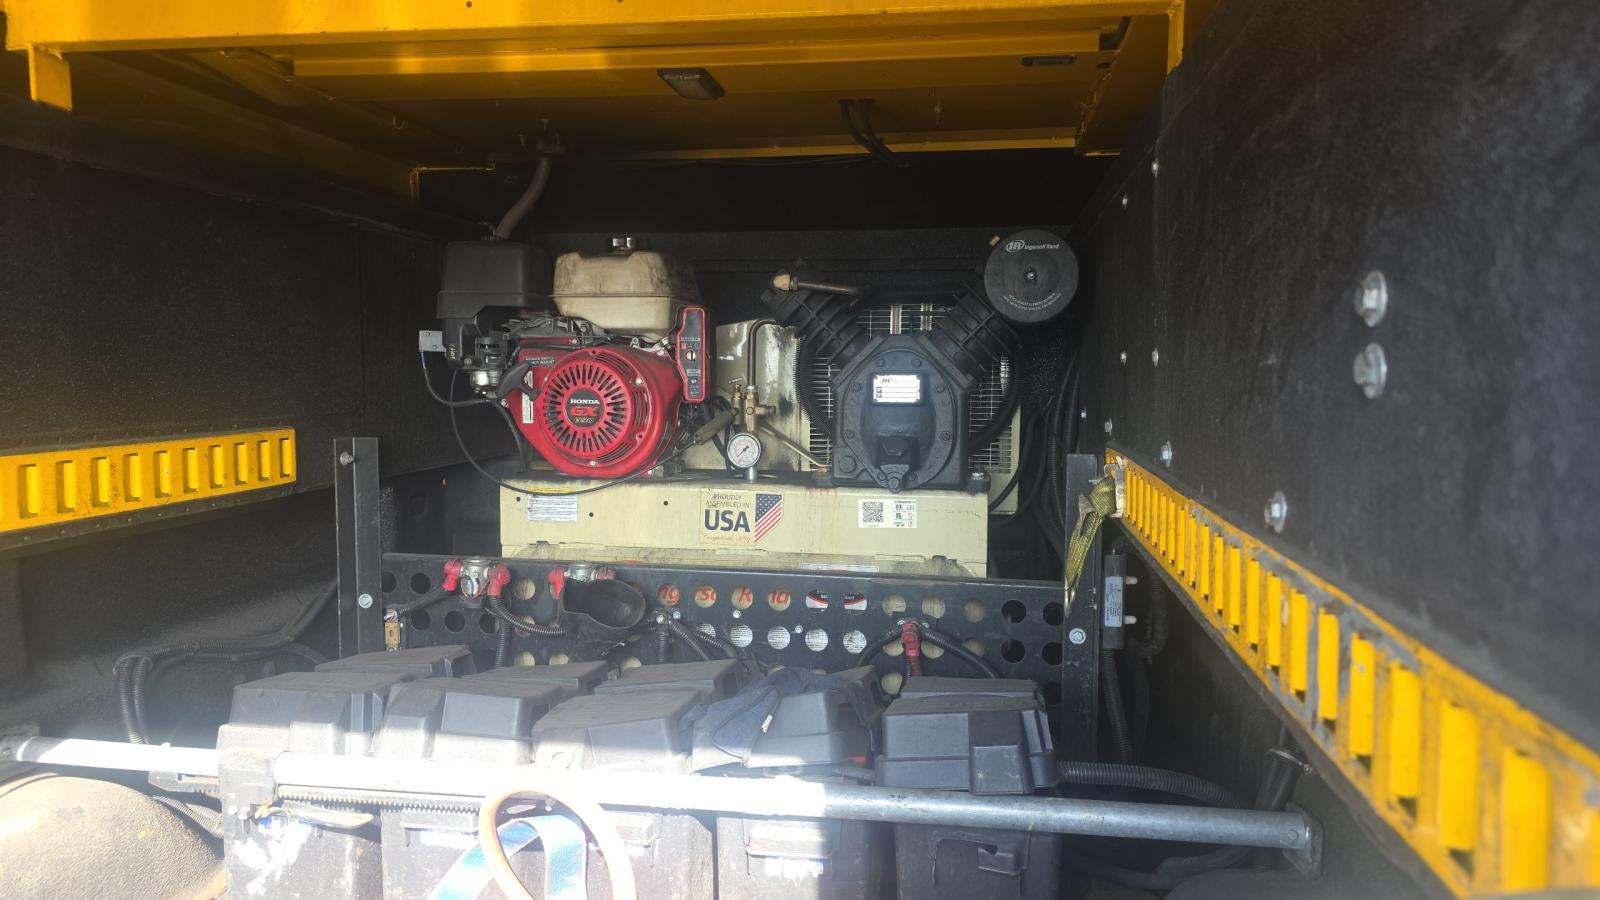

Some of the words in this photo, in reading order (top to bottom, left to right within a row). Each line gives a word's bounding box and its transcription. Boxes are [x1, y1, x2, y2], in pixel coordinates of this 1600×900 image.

[570, 406, 597, 417] GX
[706, 500, 741, 508] ASSEMBLED
[705, 509, 750, 532] USA
